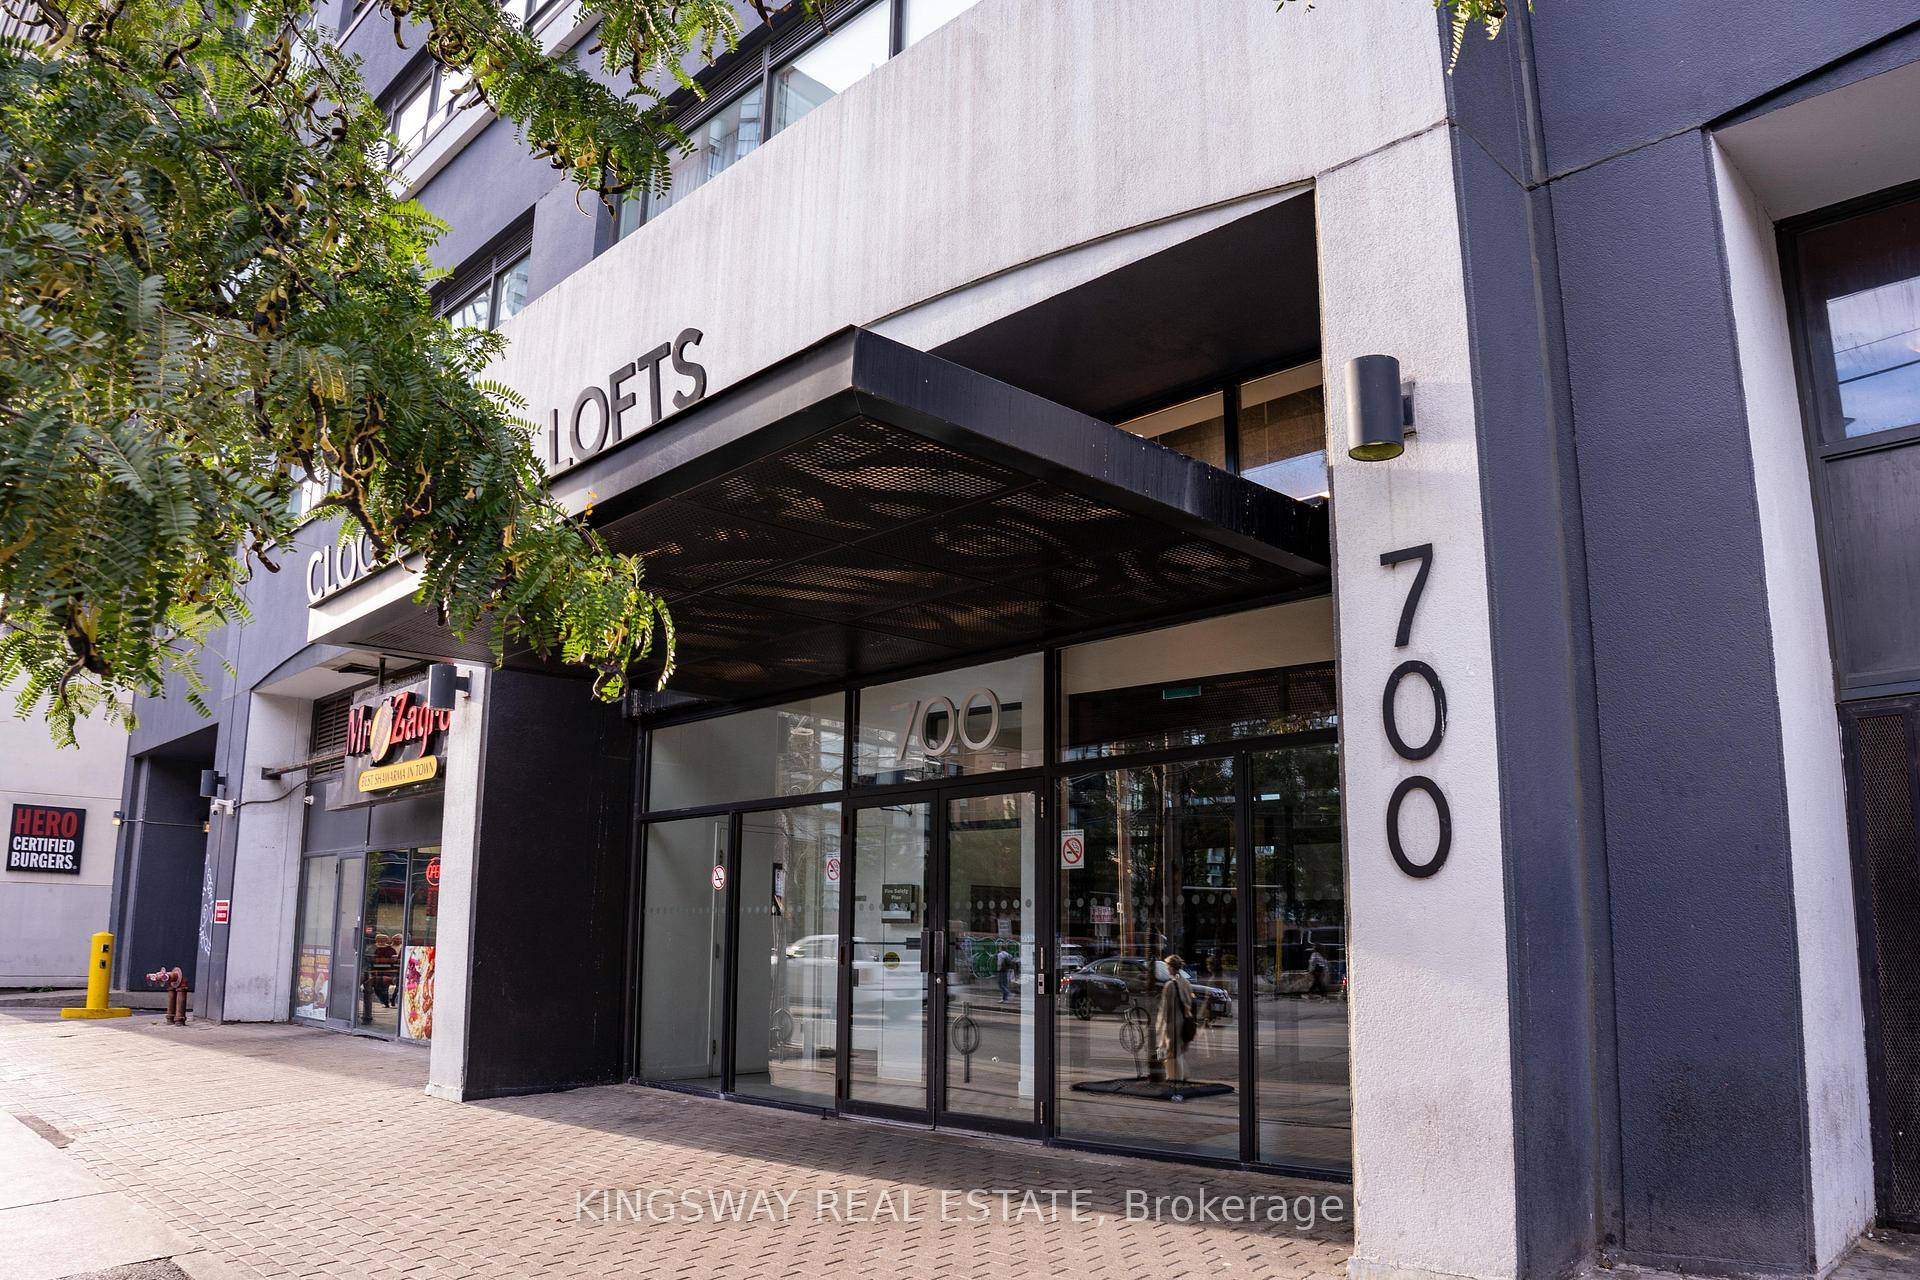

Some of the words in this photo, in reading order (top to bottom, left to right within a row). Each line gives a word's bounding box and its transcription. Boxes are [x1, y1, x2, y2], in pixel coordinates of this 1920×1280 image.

[549, 328, 708, 477] LOFTS
[346, 705, 372, 755] Mr
[1379, 543, 1452, 879] 700
[407, 766, 414, 778] IN
[415, 761, 434, 776] TOWN
[15, 808, 78, 838] HERO
[12, 836, 75, 853] CERTIFIED
